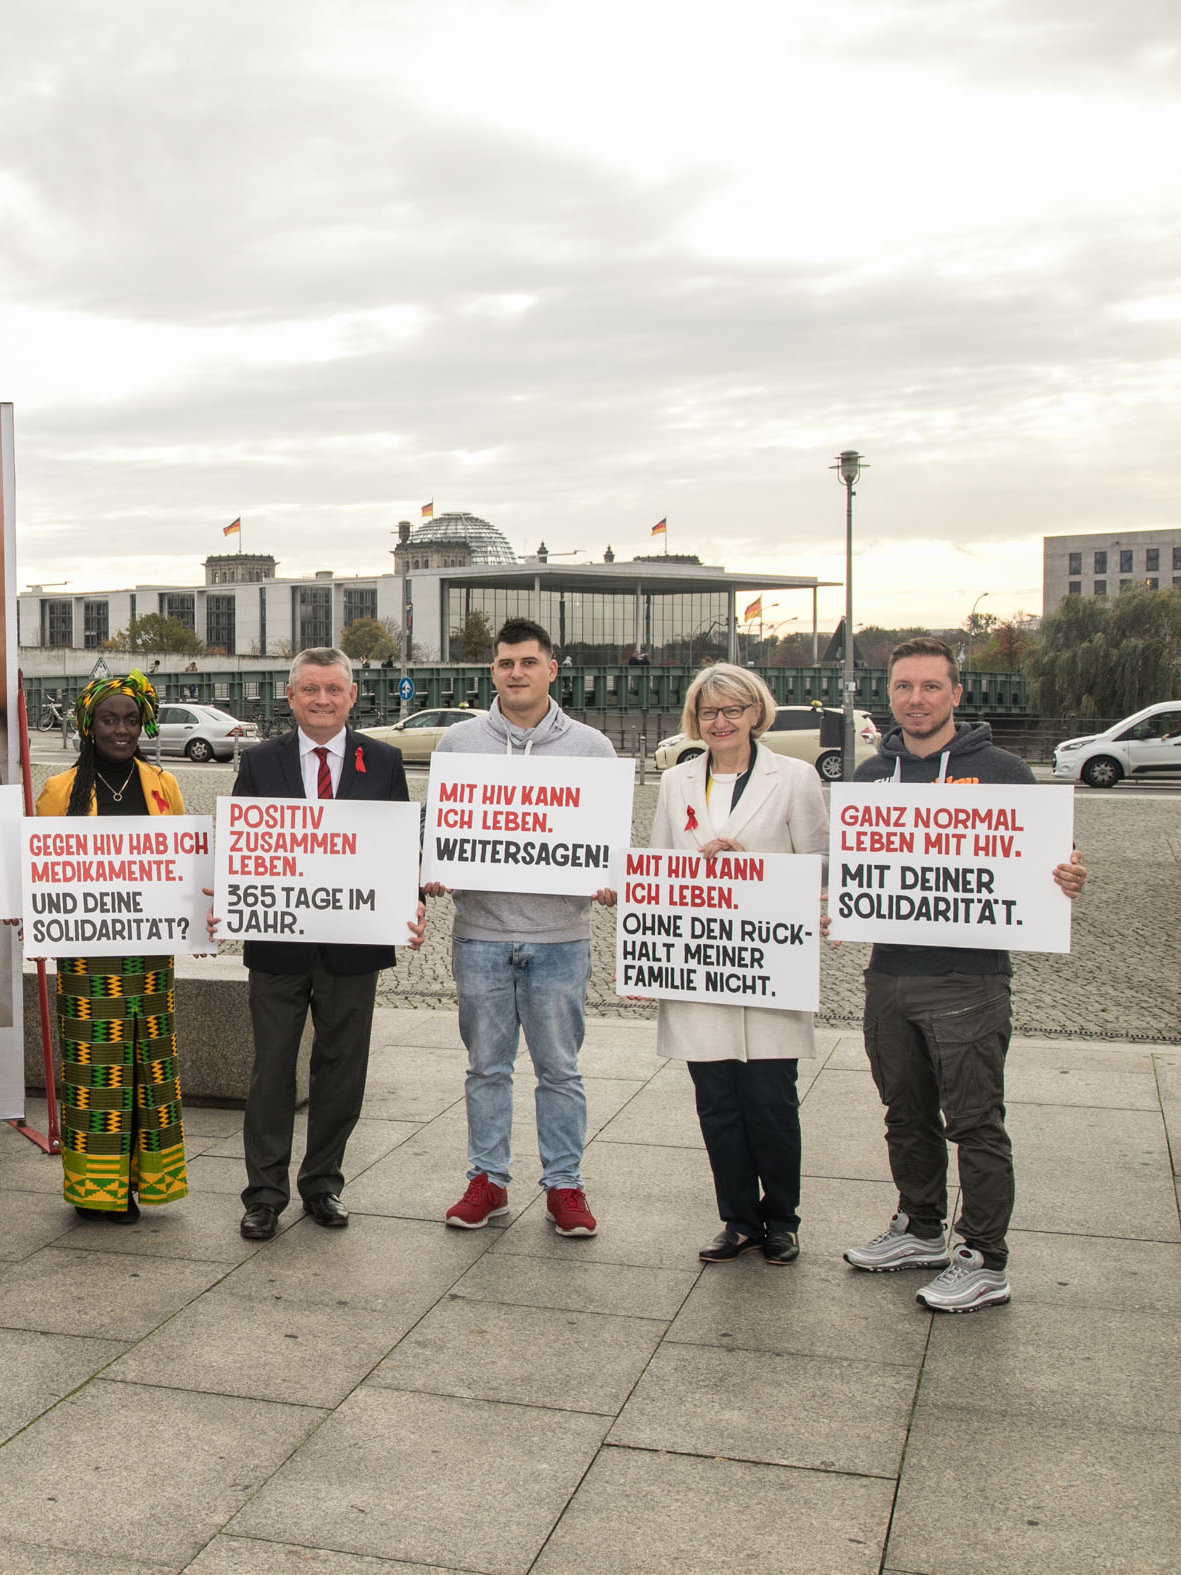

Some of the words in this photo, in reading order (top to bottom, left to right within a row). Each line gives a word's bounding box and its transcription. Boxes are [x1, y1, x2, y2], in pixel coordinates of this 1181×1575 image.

[439, 783, 477, 803] MIT
[482, 784, 516, 805] HIV
[521, 786, 580, 807] KANN
[230, 804, 324, 829] POSITIV
[437, 808, 473, 829] ICH
[482, 810, 553, 832] LEBEN.
[841, 805, 907, 827] GANZ
[914, 808, 1024, 831] NORMAL
[29, 834, 87, 856] GEGEN
[93, 834, 123, 855] HIV
[129, 833, 168, 855] HAB
[174, 832, 208, 854] ICH
[229, 831, 357, 854] ZUSAMMEN
[436, 837, 609, 868] WEITERSAGEN!
[841, 831, 914, 853] LEBEN
[924, 833, 966, 855] MIT
[974, 835, 1022, 858] HIV.
[31, 860, 183, 883] MEDIKAMENTE.
[228, 855, 304, 876] LEBEN.
[626, 854, 662, 876] MIT
[668, 856, 700, 878] HIV
[706, 857, 764, 881] KANN
[841, 864, 891, 889] MIT
[901, 866, 994, 894] DEINER
[32, 892, 77, 914] UND
[83, 892, 143, 913] DEINE
[228, 884, 276, 908] 365
[281, 887, 343, 910] TAGE
[349, 888, 375, 911] IM
[625, 882, 660, 905] ICH
[669, 885, 738, 909] LEBEN.
[839, 892, 1023, 925] SOLIDARITÄT.
[33, 917, 189, 943] SOLIDARITÄT?
[227, 910, 304, 934] JAHR.
[623, 913, 683, 938] OHNE
[690, 917, 733, 941] DEN
[741, 920, 812, 945] RÜCK-
[623, 940, 675, 962] HALT
[684, 943, 764, 969] MEINER
[624, 965, 697, 991] FAMILIE
[705, 971, 776, 997] NICHT.
